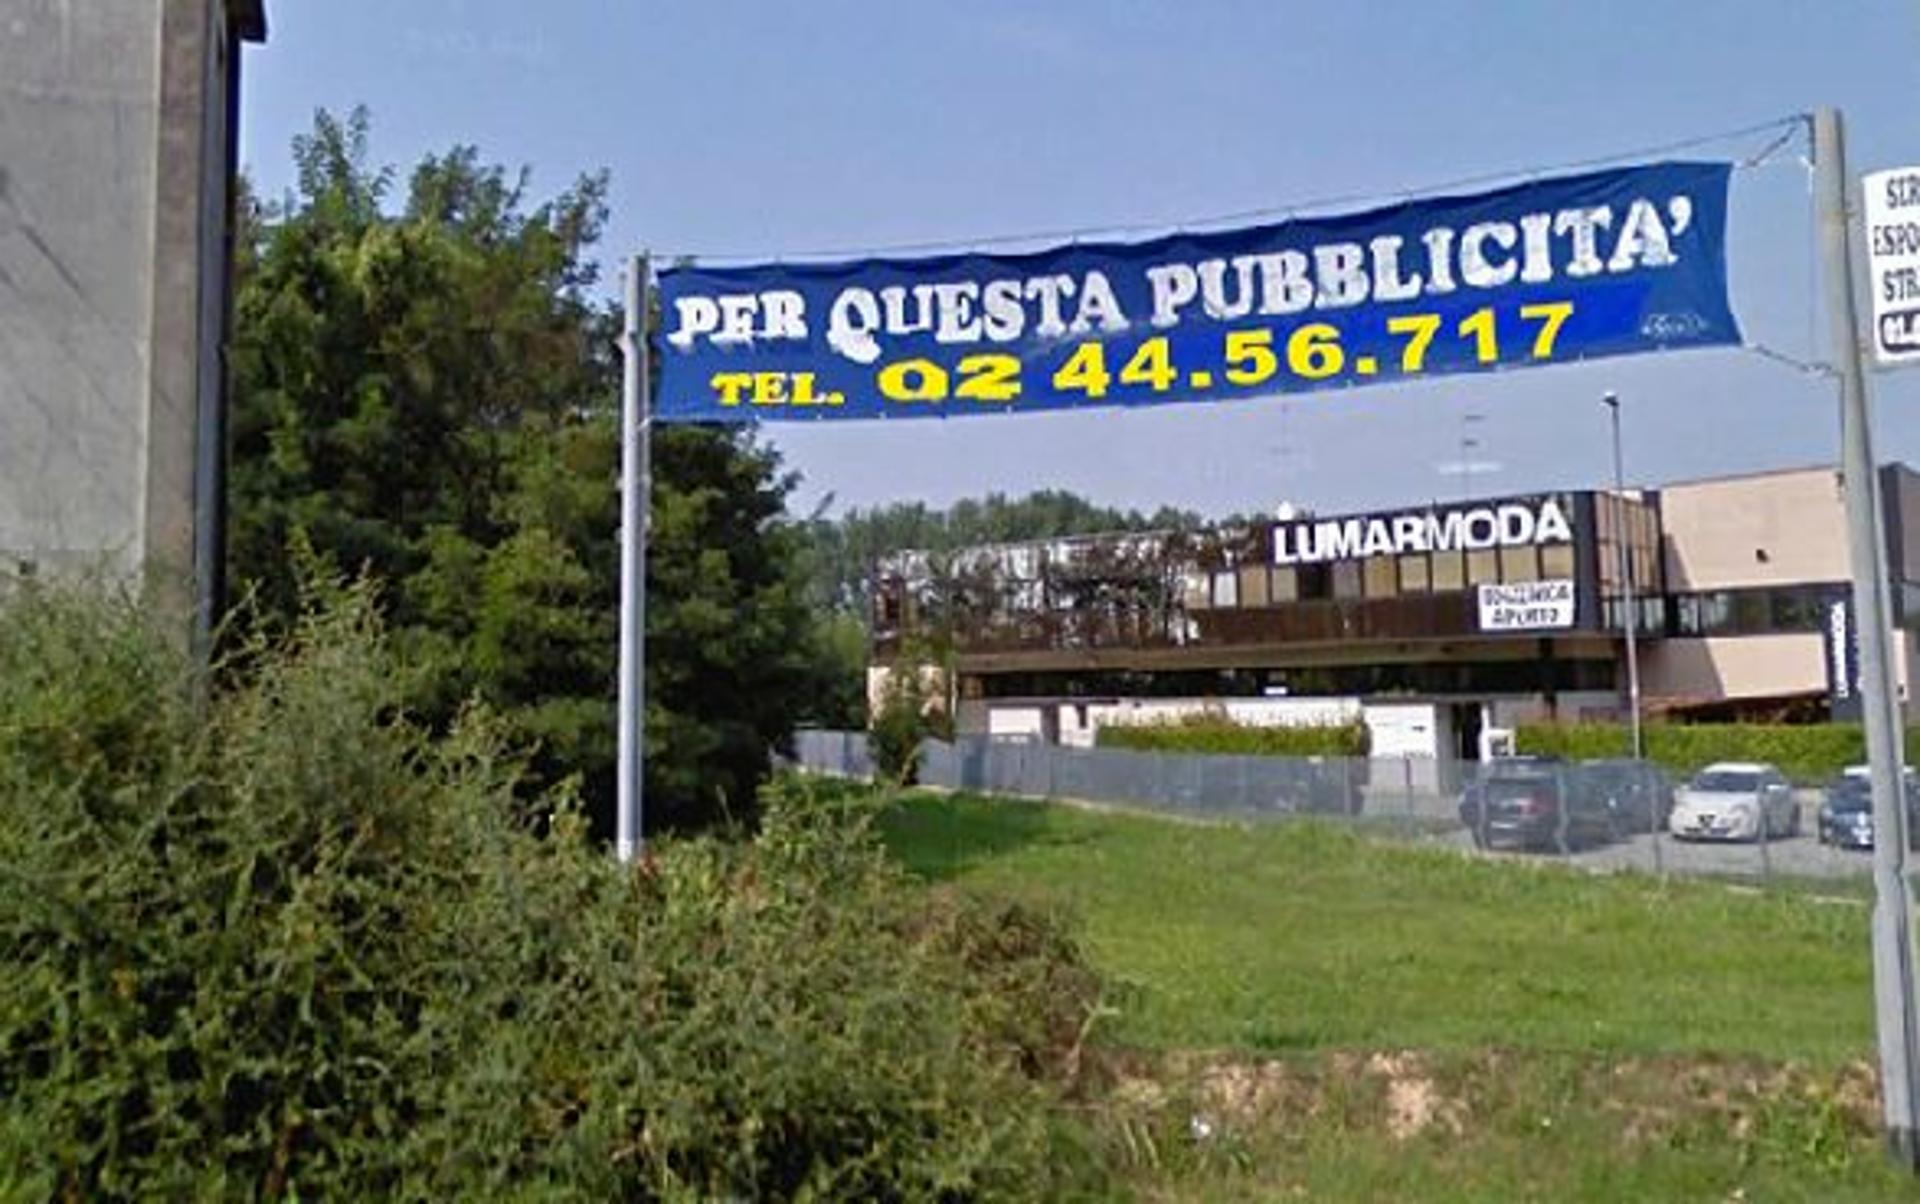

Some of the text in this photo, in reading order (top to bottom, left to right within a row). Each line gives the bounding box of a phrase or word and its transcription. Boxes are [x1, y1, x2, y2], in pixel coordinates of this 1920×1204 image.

[668, 196, 1692, 363] PER QUESTA PUBBLICITA'
[710, 302, 1574, 405] TEL. 02 44.56.717
[1273, 501, 1572, 564] LUMARMODA
